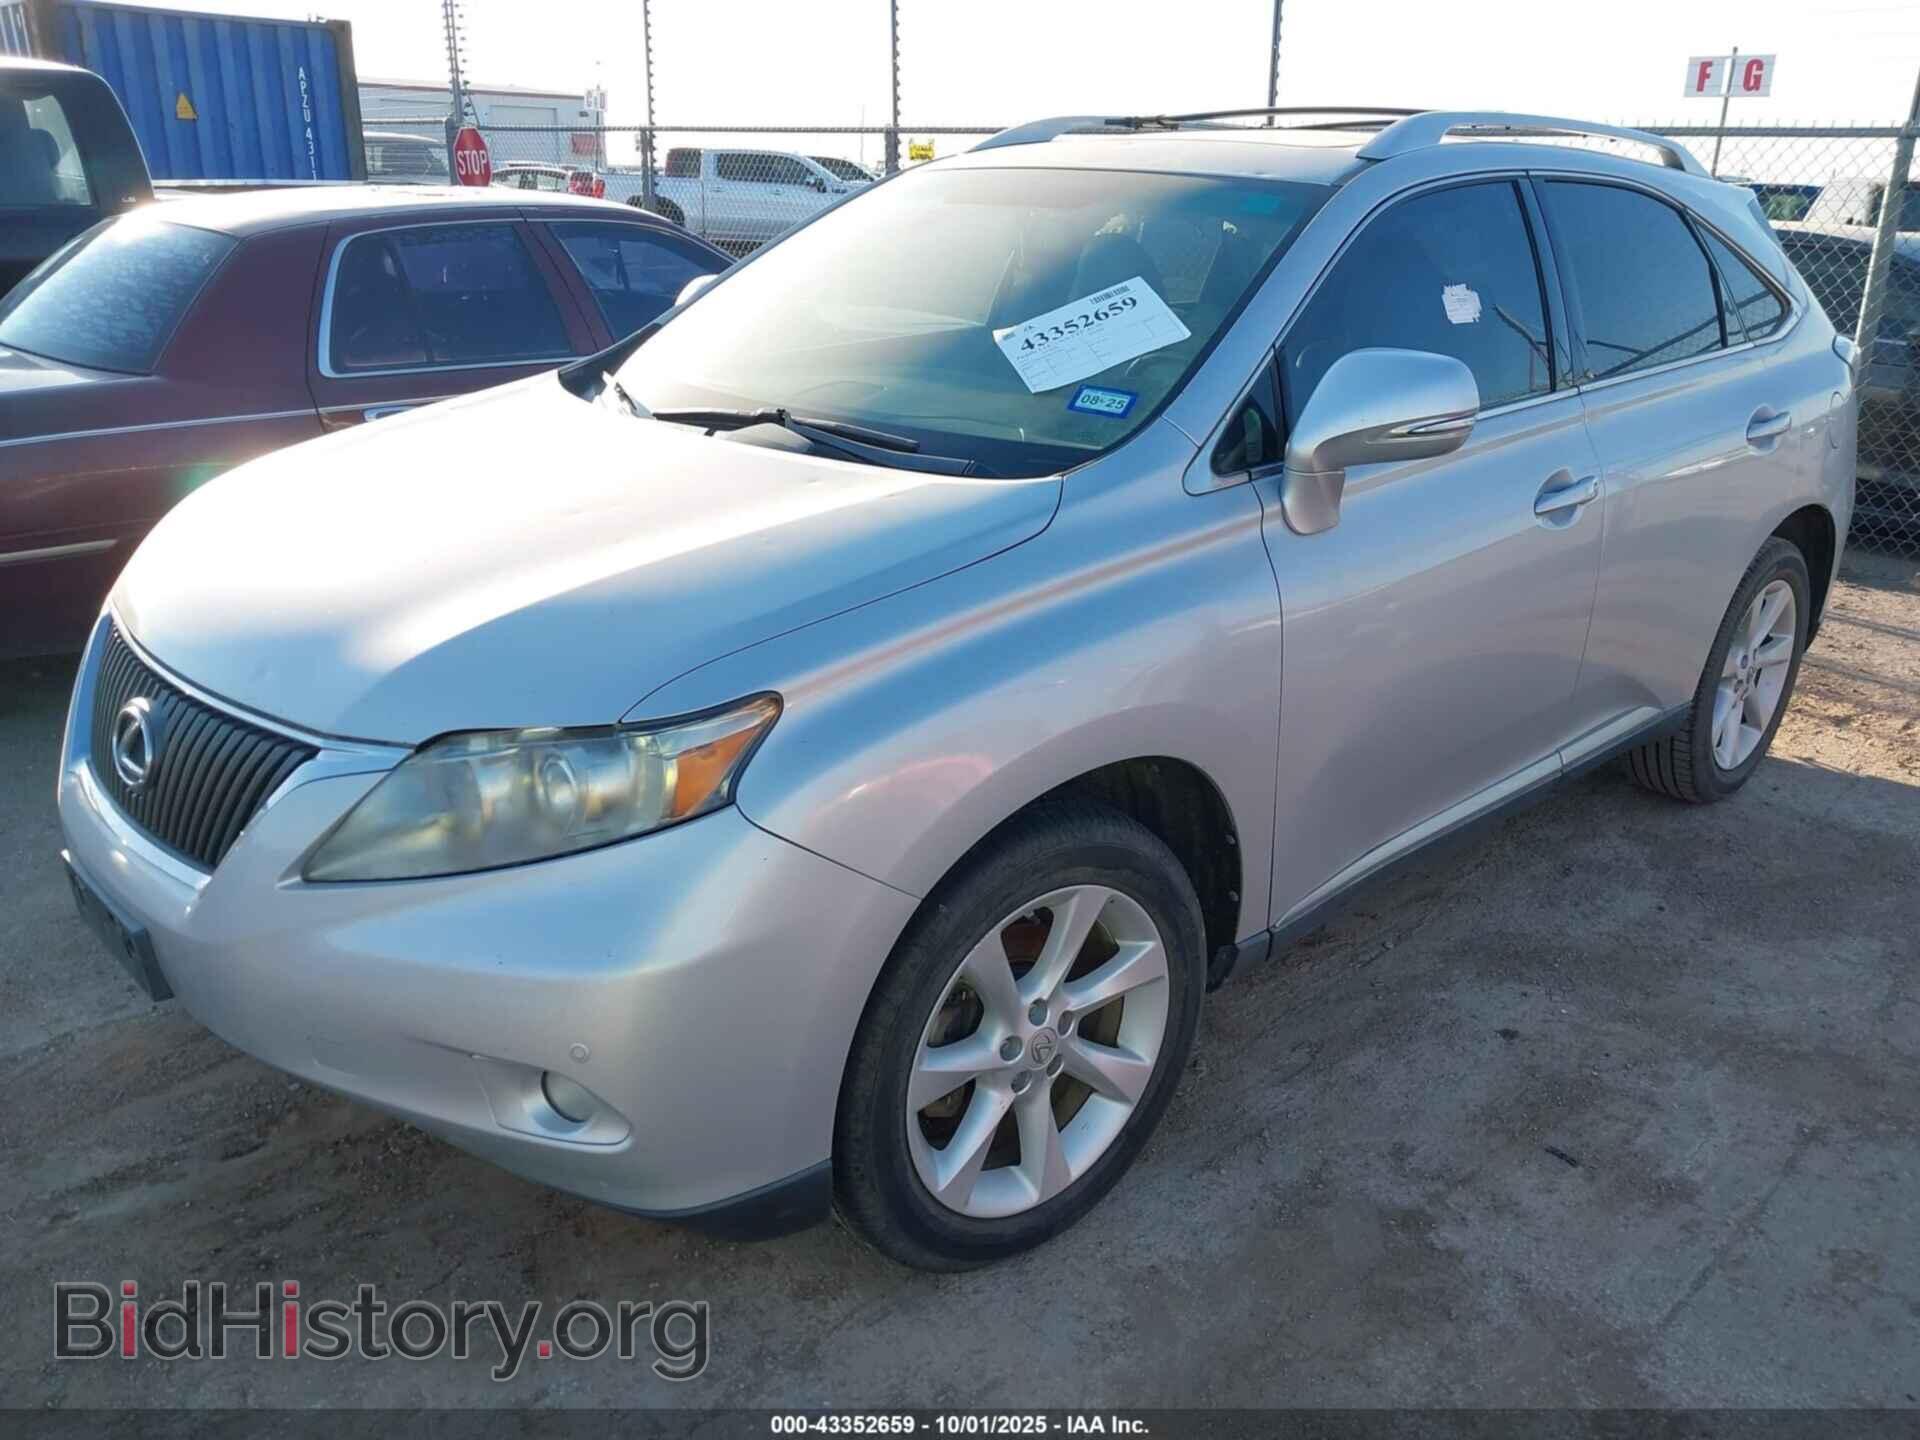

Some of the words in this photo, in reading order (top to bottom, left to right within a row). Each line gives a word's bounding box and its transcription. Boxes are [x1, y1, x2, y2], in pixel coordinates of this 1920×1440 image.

[298, 66, 311, 122] APZU
[1695, 60, 1713, 92] F
[1743, 58, 1764, 92] G
[457, 150, 487, 175] STOP
[1020, 296, 1137, 351] 43352659
